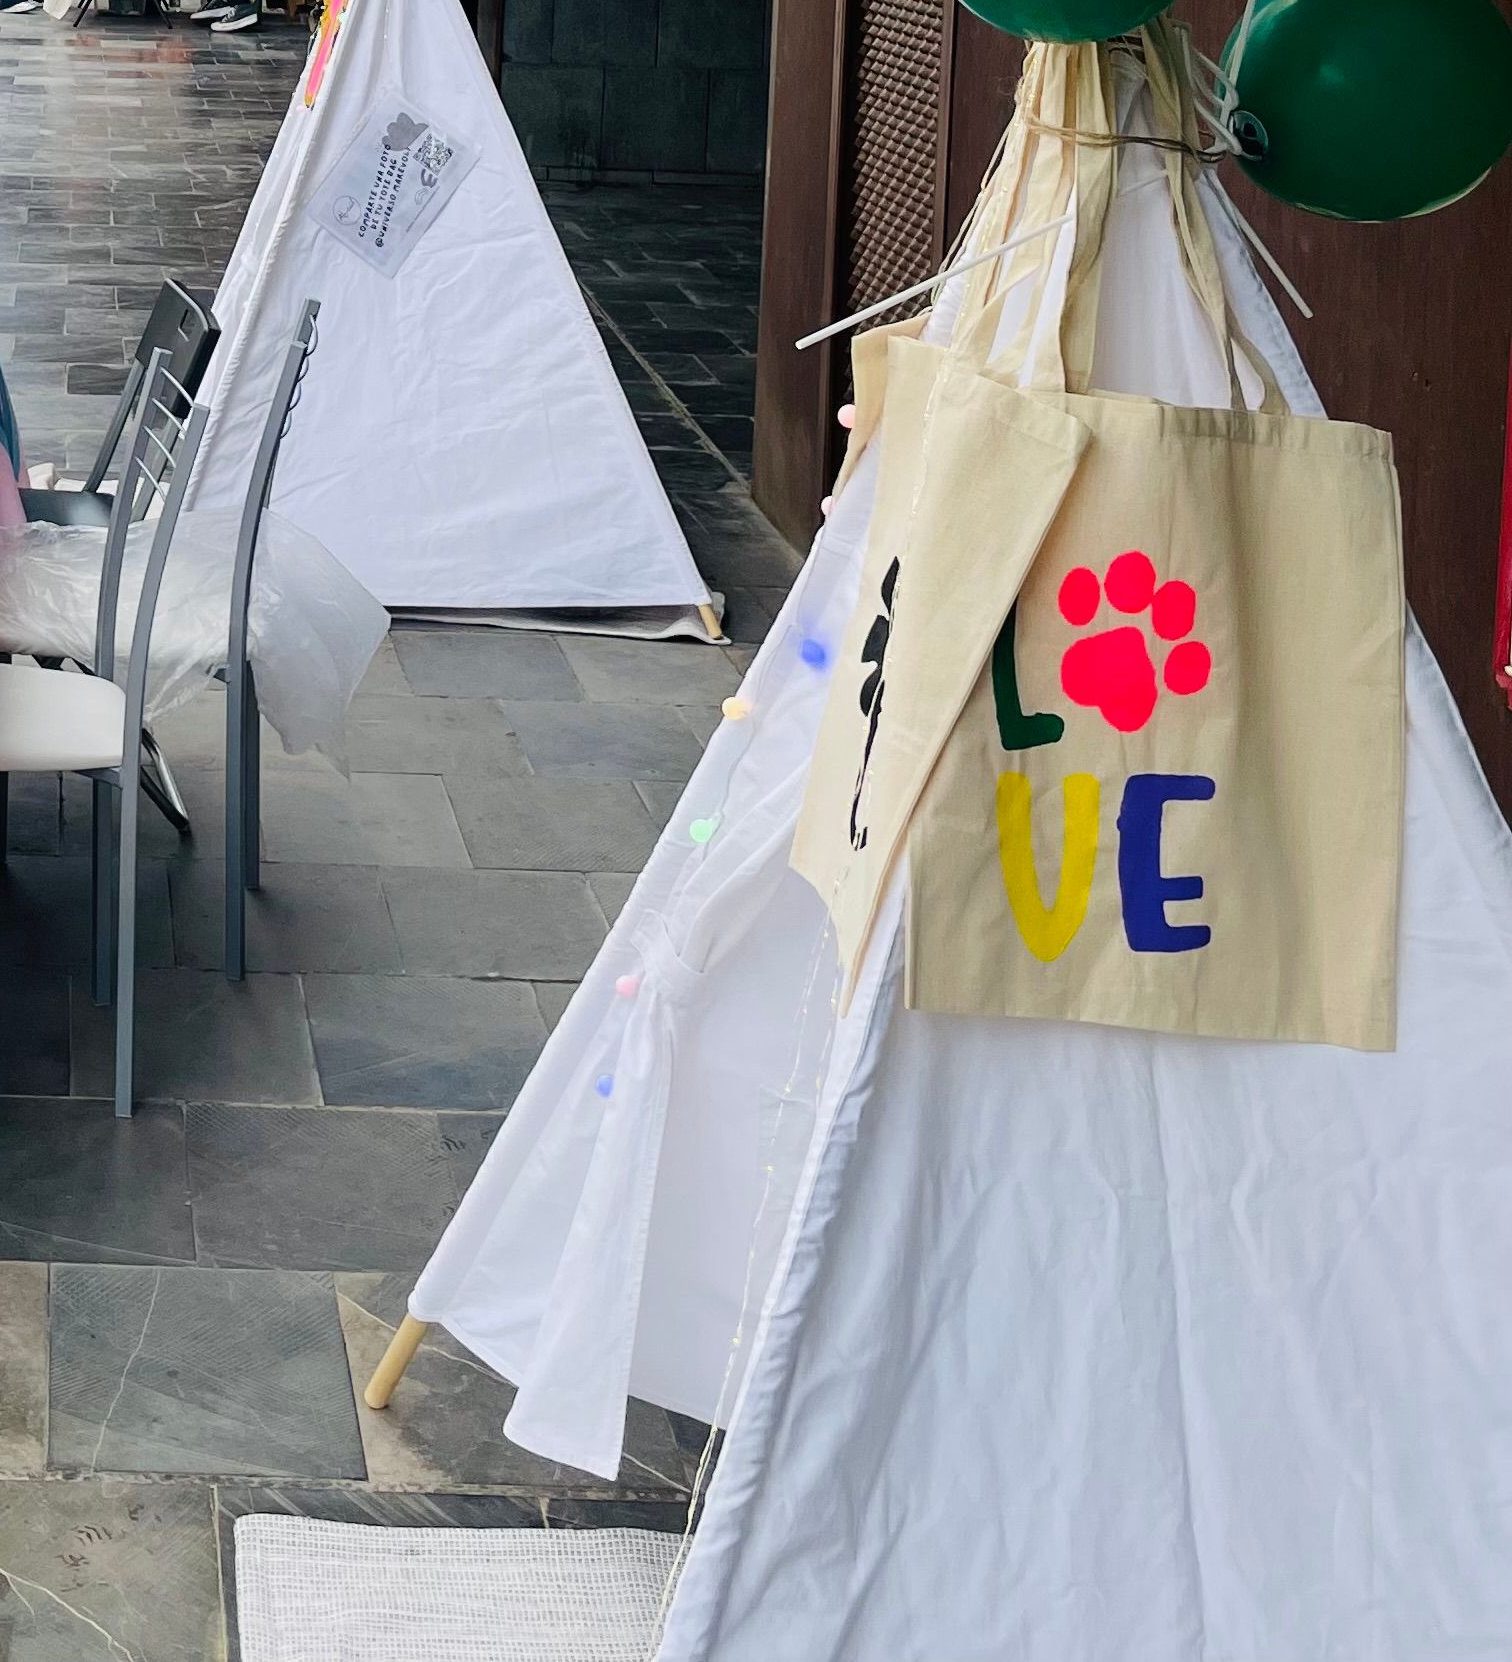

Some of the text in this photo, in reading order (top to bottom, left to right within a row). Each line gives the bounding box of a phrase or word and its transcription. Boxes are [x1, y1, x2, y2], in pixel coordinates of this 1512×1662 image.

[359, 144, 391, 237] COMPARTE UNA FOTO
[371, 159, 397, 230] DE TU TOTE BAG
